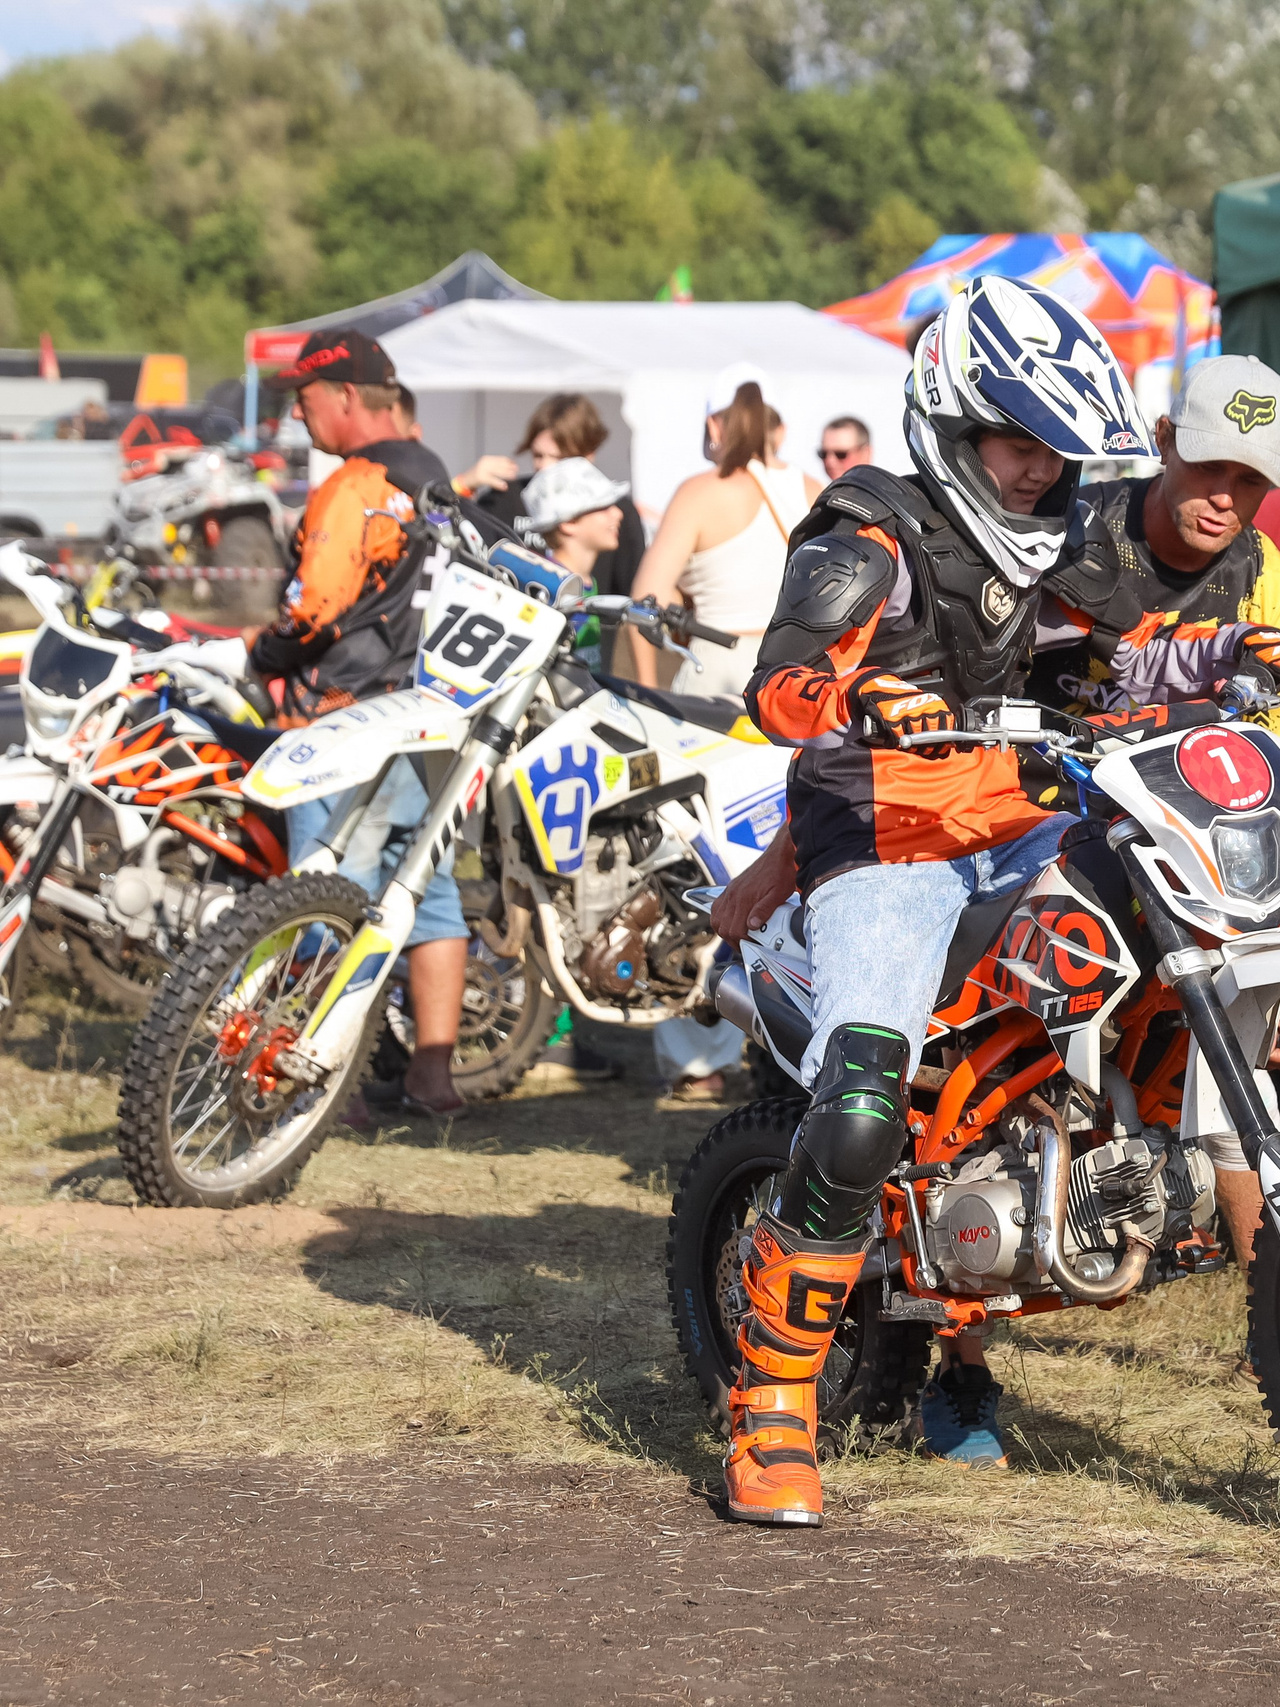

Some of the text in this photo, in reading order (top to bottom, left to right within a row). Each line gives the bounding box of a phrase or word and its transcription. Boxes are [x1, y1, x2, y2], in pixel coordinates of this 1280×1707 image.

[423, 603, 533, 684] 181
[890, 692, 943, 717] FOX
[1207, 746, 1240, 784] 1
[1069, 991, 1104, 1015] 125
[958, 1226, 990, 1244] KAYO
